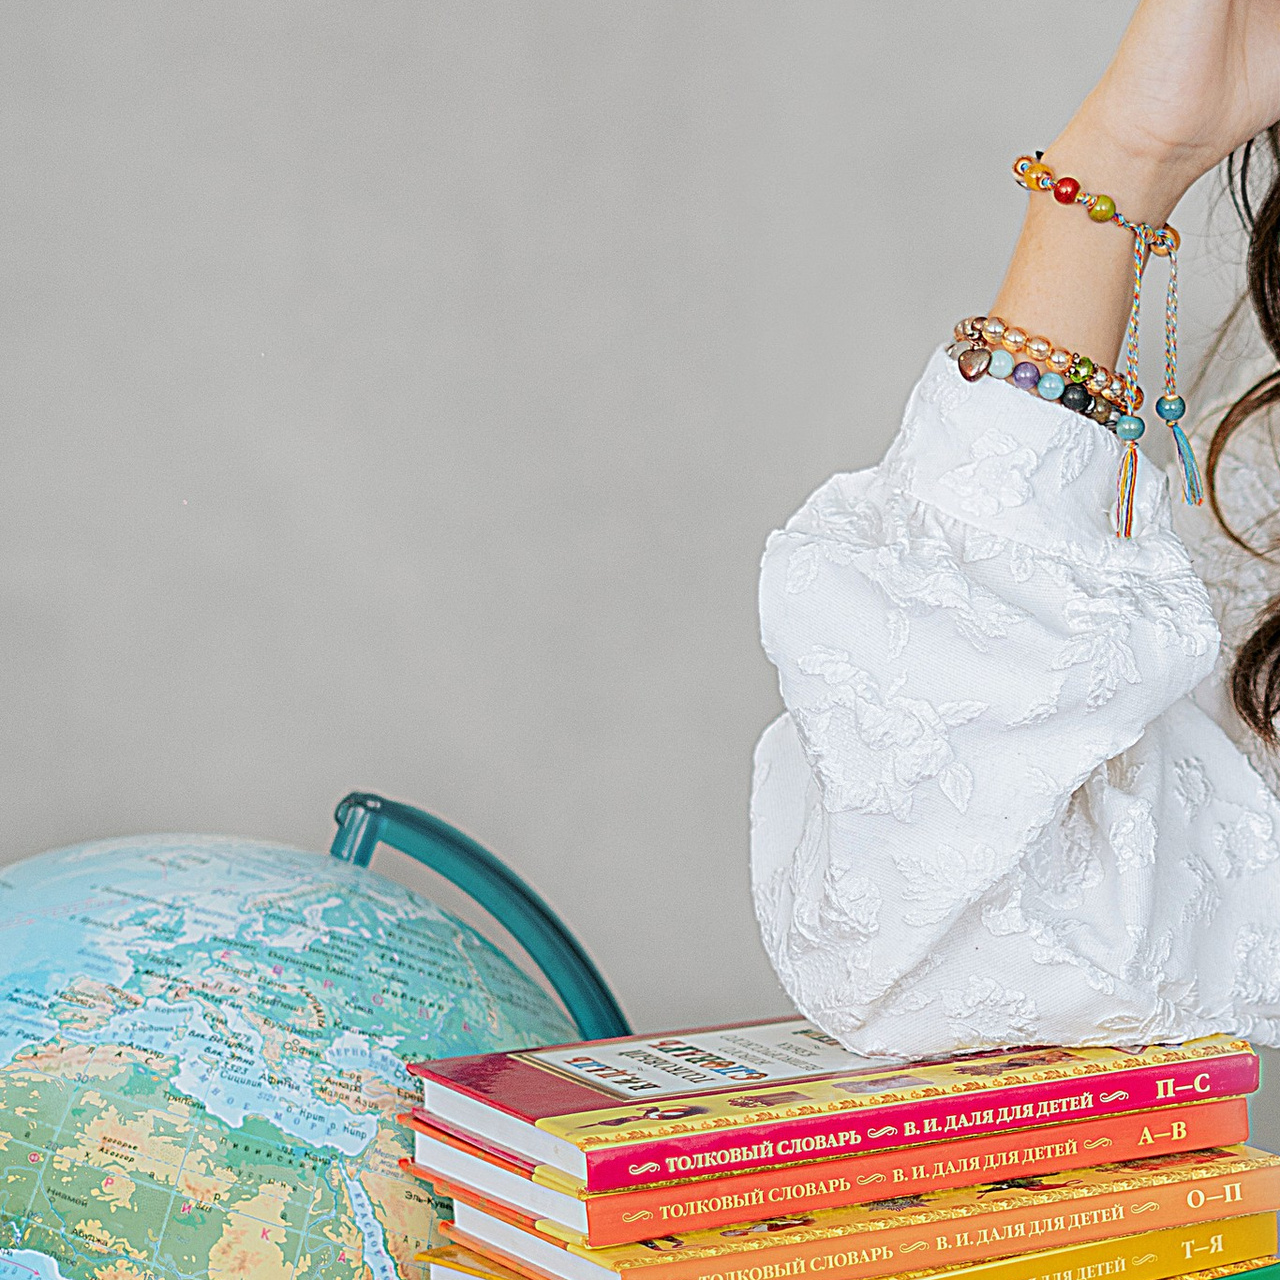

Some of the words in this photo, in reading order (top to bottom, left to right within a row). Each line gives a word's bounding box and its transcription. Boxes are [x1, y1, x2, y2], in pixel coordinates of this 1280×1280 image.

[126, 1041, 165, 1059] Алжир
[220, 1072, 263, 1089] Сицилия
[666, 1142, 774, 1173] ТОЛКОВЫЙ
[777, 1130, 861, 1157] СЛОВАРЬ
[945, 1109, 993, 1130] ДАЛЯ
[996, 1103, 1034, 1122] ДЛЯ
[1037, 1092, 1094, 1117] ДЕТЕЙ
[102, 1136, 138, 1151] нагорье
[98, 1147, 135, 1163] Ахаггар
[659, 1190, 763, 1220] ТОЛКОВЫЙ
[769, 1178, 851, 1203] СЛОВАРЬ
[932, 1156, 979, 1178] ДАЛЯ
[982, 1150, 1019, 1169] ДЛЯ
[1022, 1138, 1078, 1164] ДЕТЕЙ
[47, 1187, 88, 1208] Ниамей
[354, 1192, 381, 1257] КРАСНОЕ
[71, 1228, 108, 1246] Абуджа
[810, 1246, 893, 1272] СЛОВАРЬ
[977, 1223, 1025, 1246] ДАЛЯ
[1028, 1217, 1065, 1236] ДЛЯ
[1068, 1204, 1125, 1230] ДЕТЕЙ
